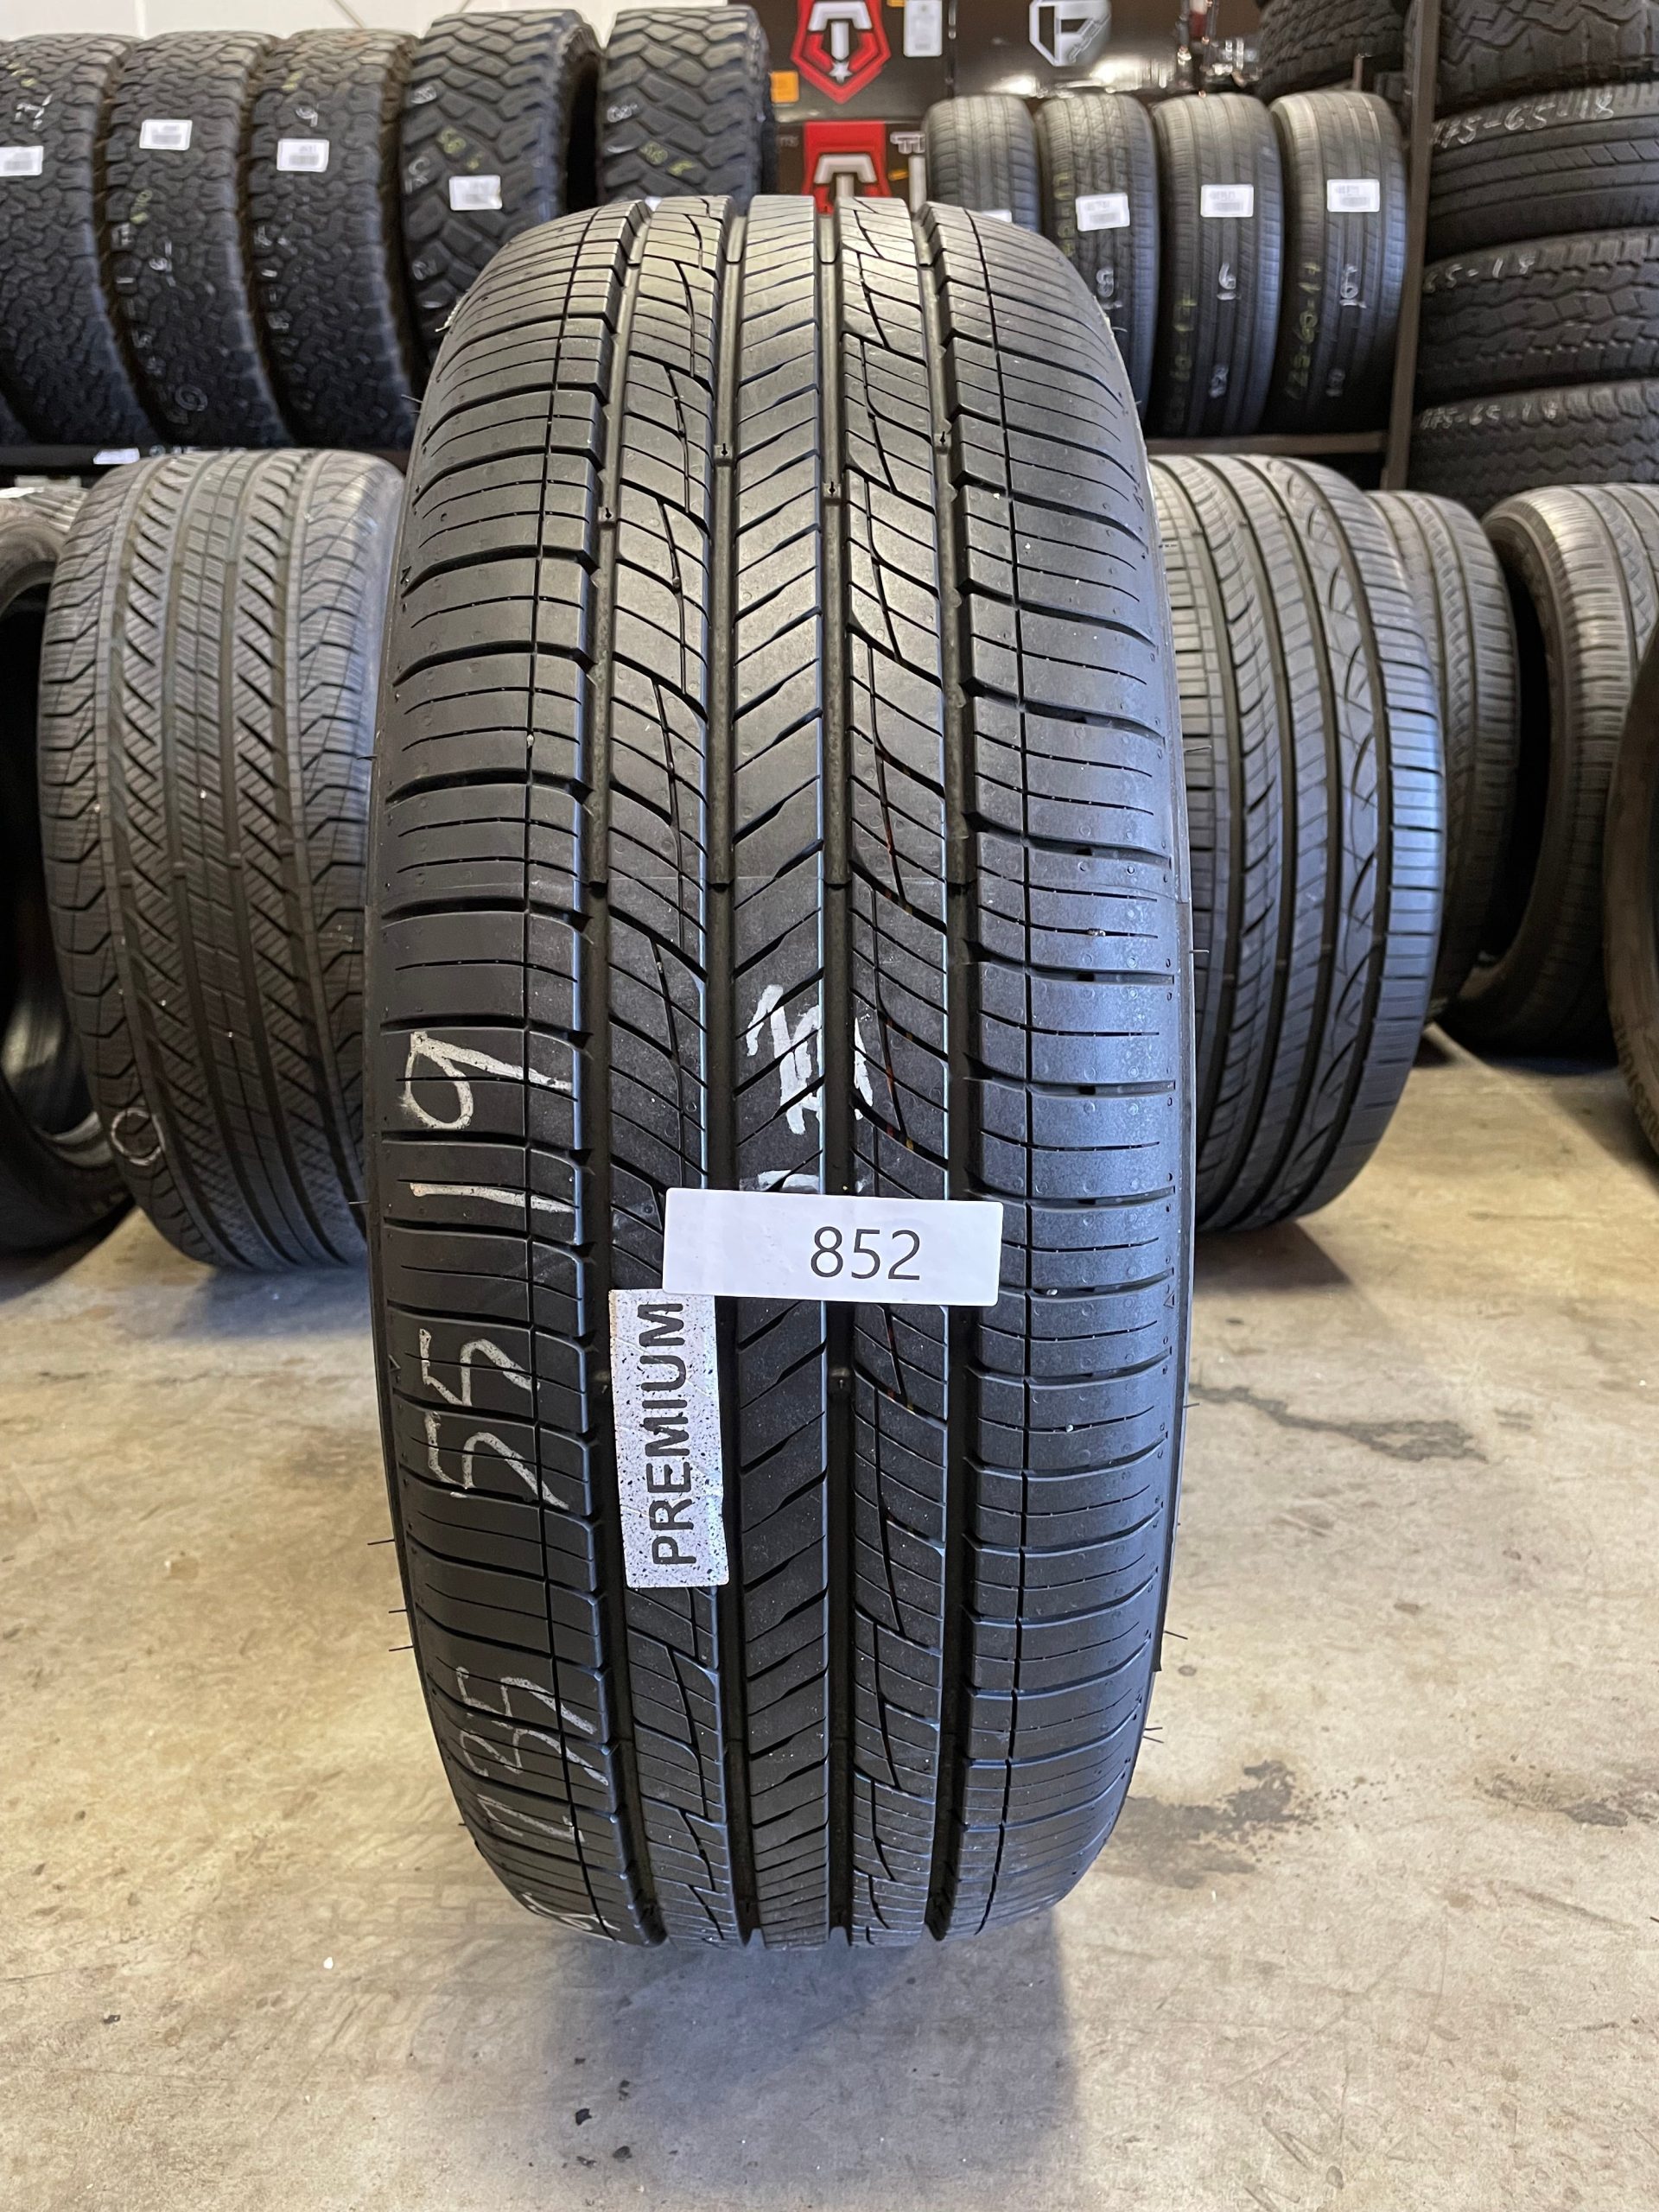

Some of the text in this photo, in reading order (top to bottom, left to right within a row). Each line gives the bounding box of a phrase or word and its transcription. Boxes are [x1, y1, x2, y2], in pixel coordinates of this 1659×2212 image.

[398, 1031, 579, 1215] 19
[810, 1225, 921, 1282] 852
[418, 1326, 570, 1510] 55
[638, 1301, 696, 1566] PREMIUM
